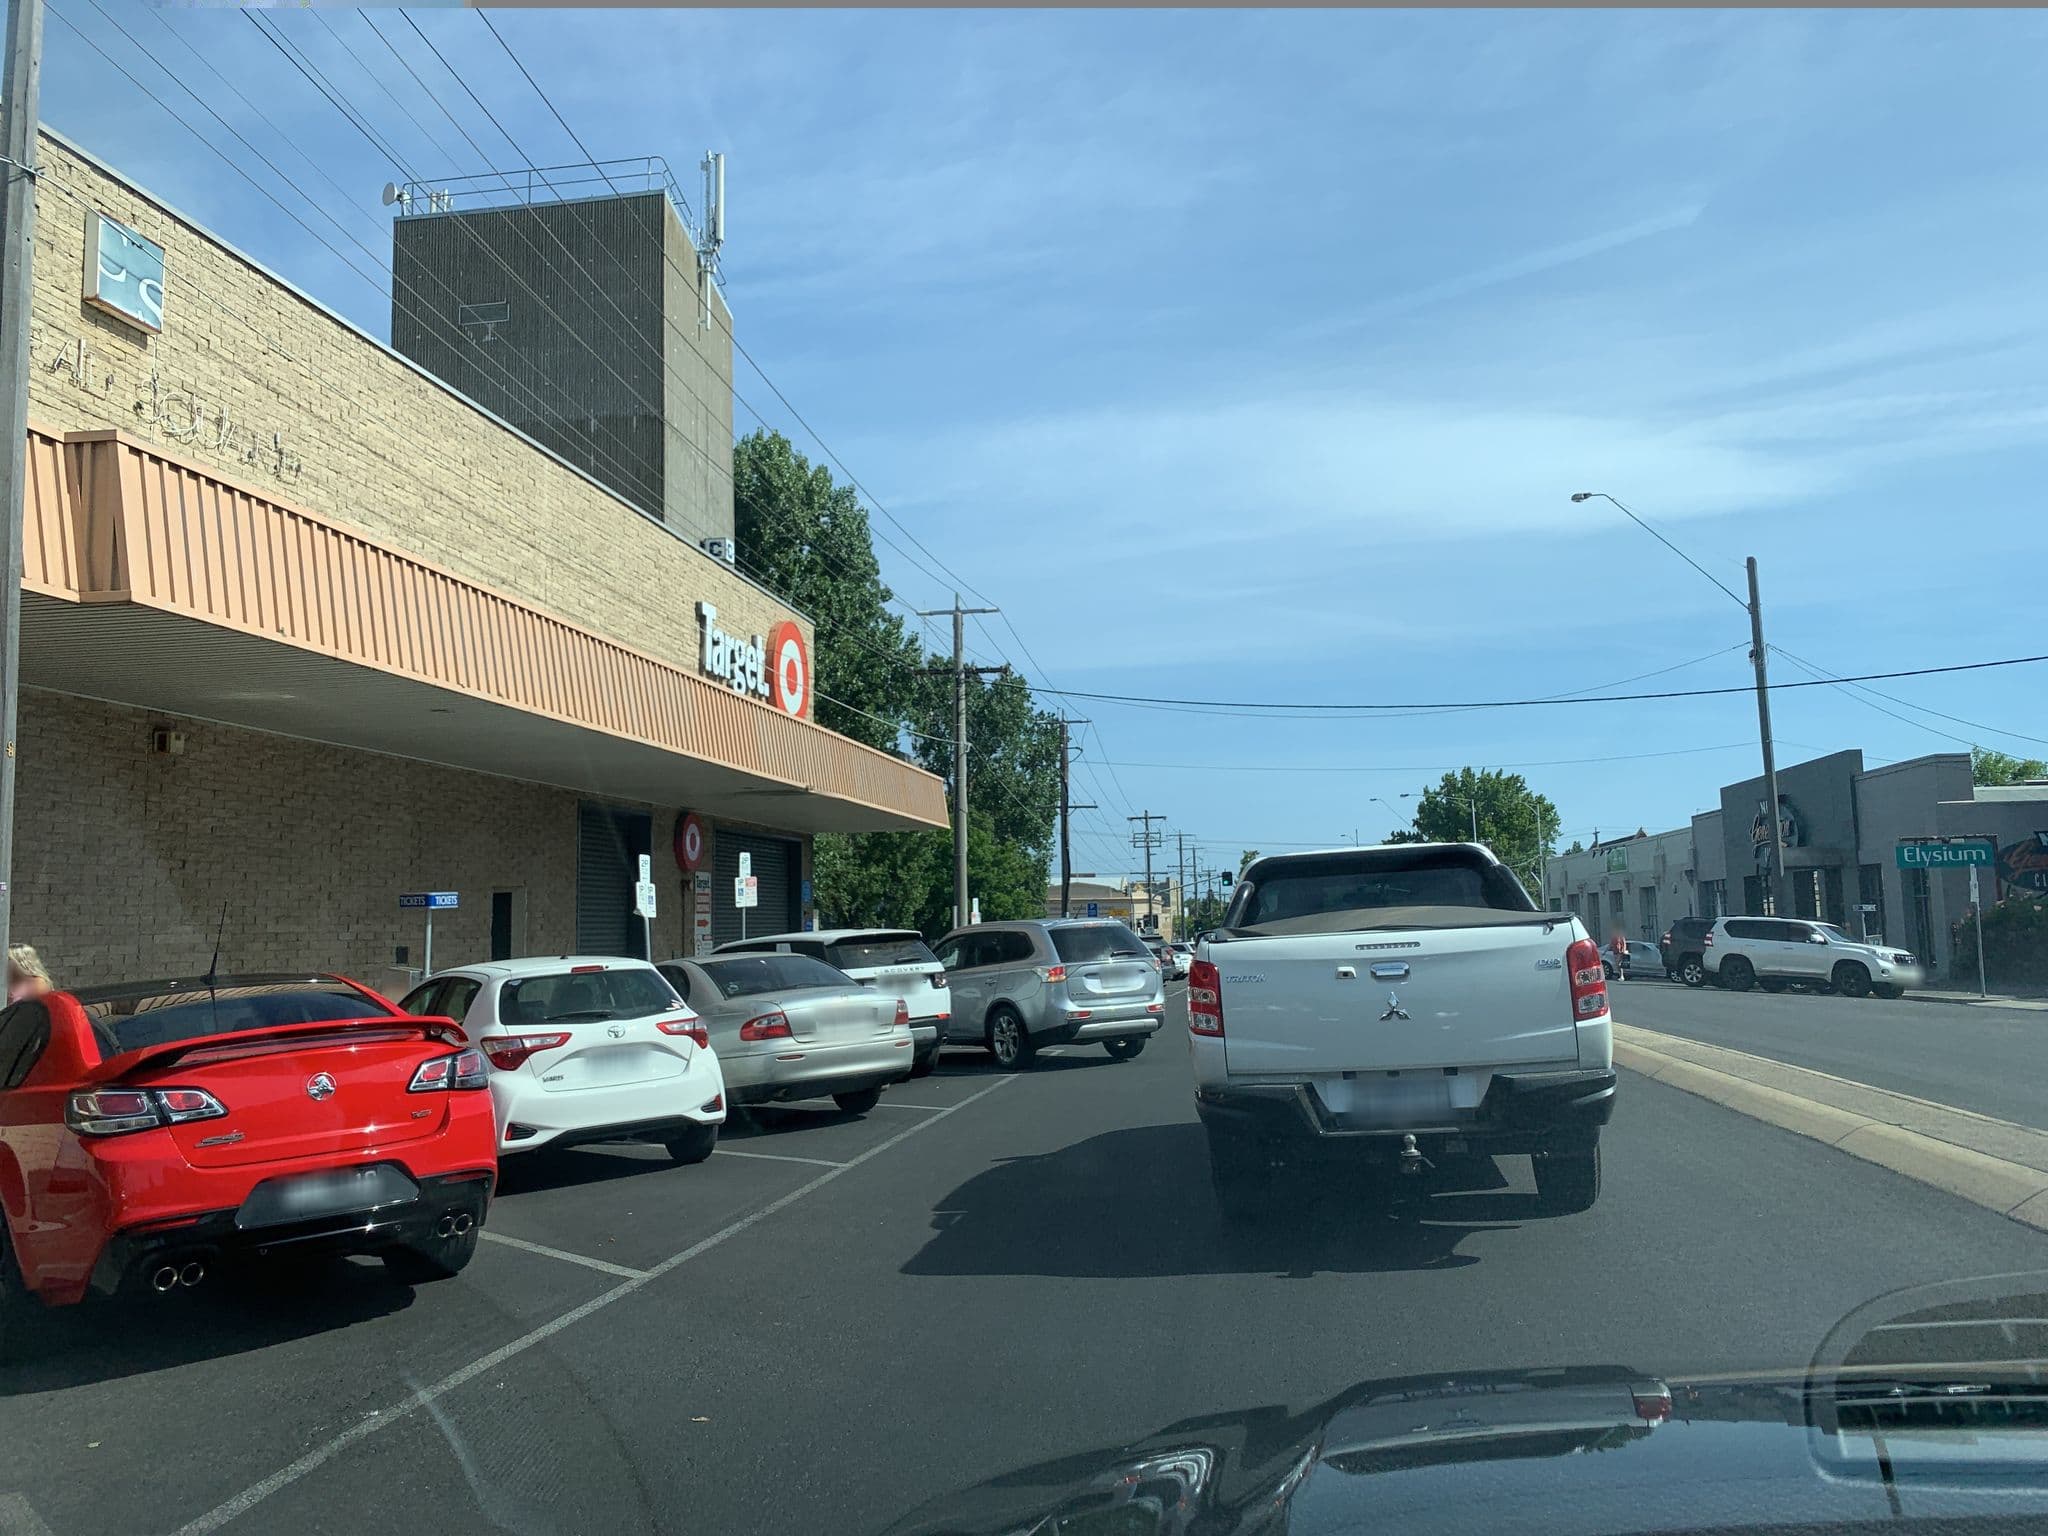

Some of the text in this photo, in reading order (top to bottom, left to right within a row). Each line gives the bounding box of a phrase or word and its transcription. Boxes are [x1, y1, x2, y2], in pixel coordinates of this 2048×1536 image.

[699, 601, 769, 697] Target
[1903, 846, 1986, 867] Elysium
[400, 896, 426, 905] TICKETS
[435, 896, 458, 905] TICKETS
